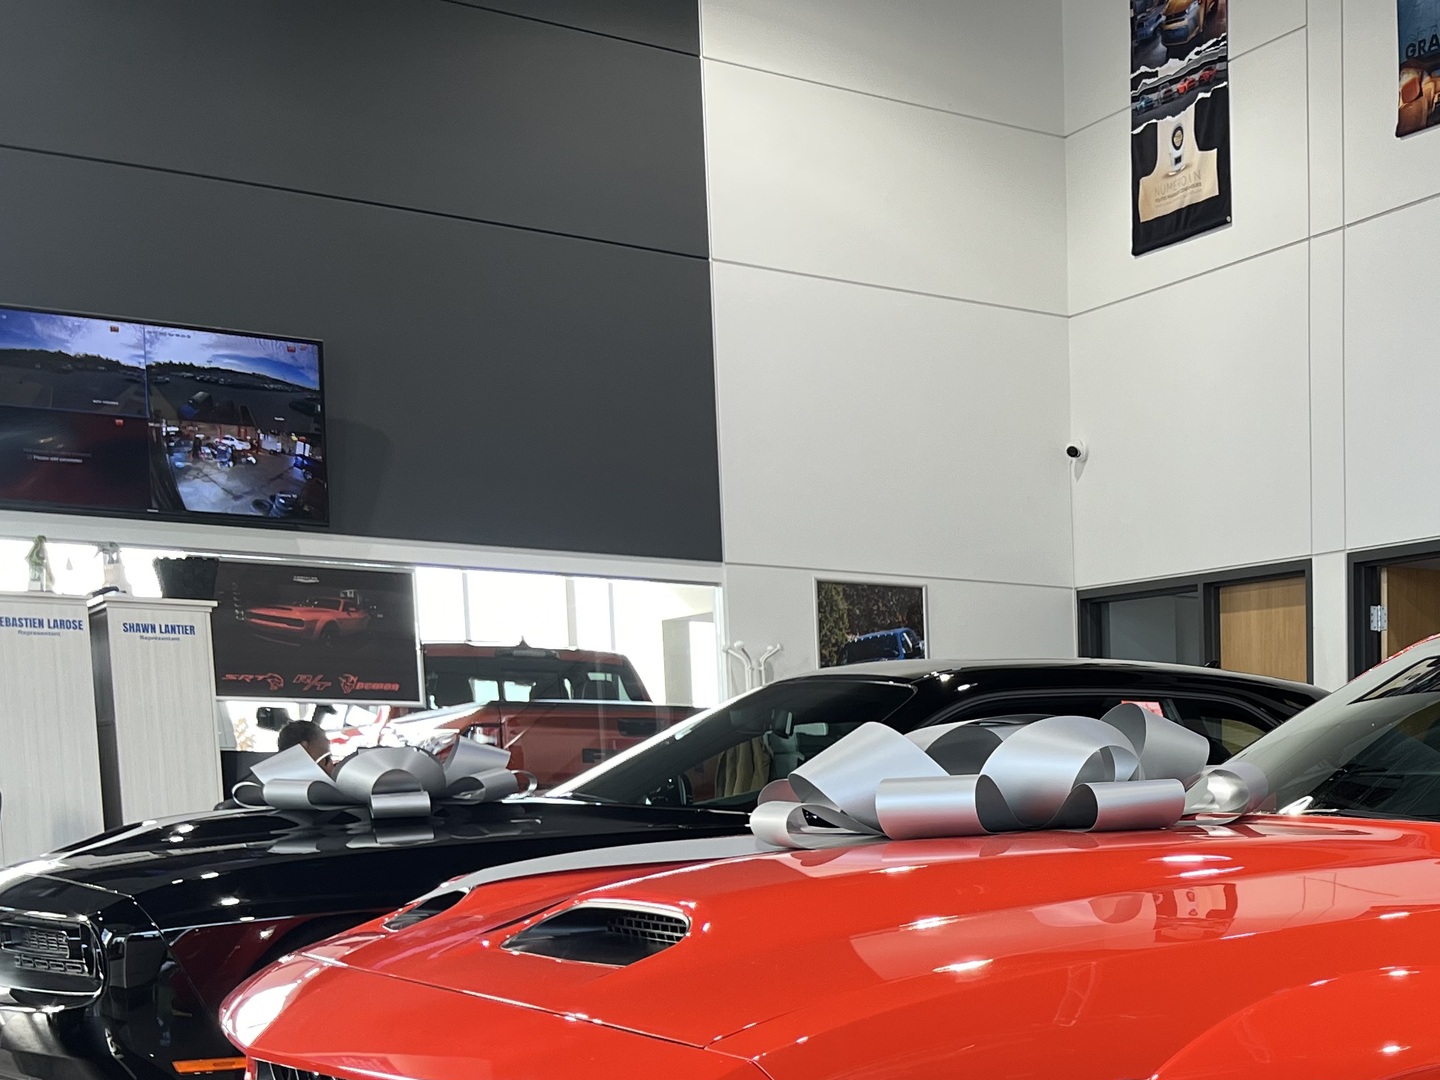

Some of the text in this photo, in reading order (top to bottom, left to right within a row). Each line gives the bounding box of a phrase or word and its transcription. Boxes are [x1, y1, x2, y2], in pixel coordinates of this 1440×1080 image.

[47, 618, 84, 631] LAROSE
[122, 622, 196, 636] SHAWN LANTIER
